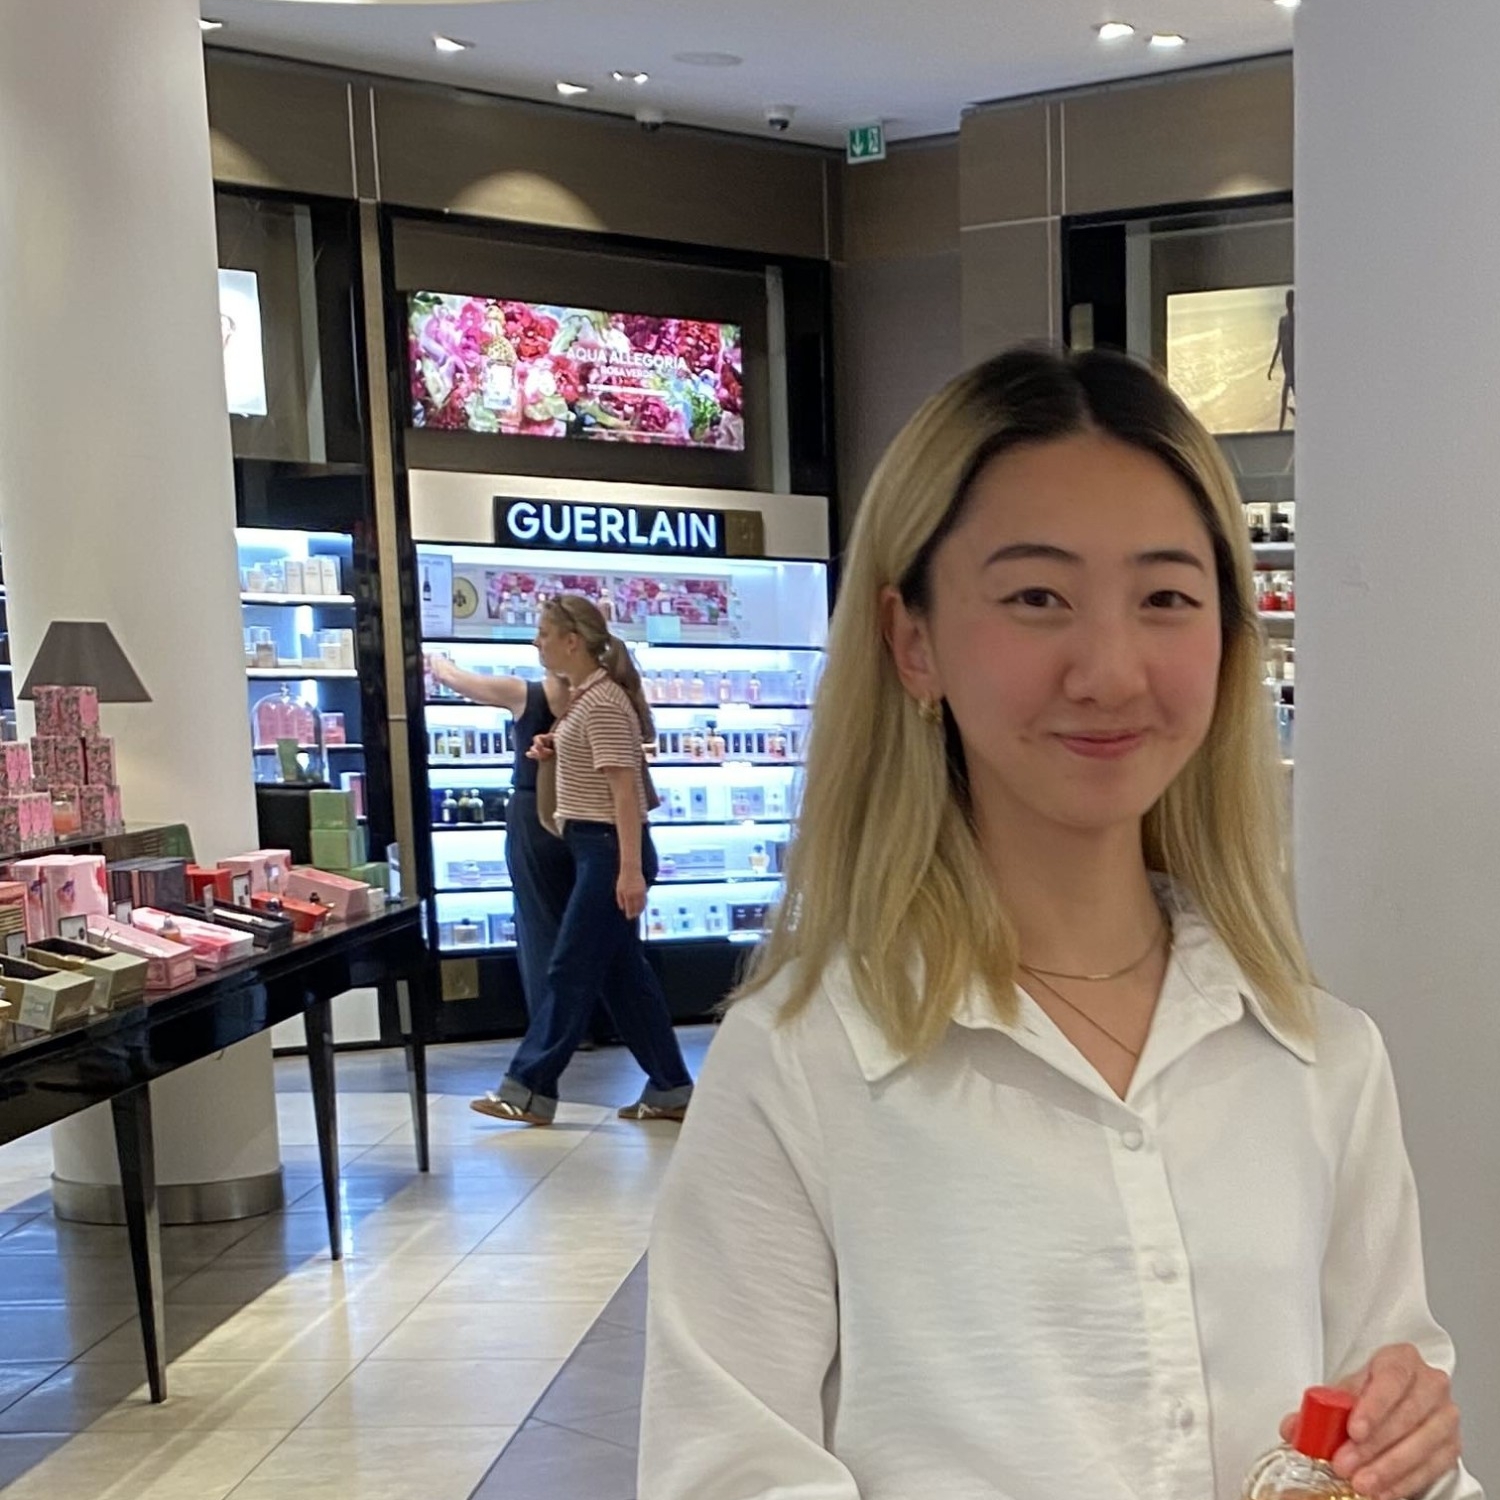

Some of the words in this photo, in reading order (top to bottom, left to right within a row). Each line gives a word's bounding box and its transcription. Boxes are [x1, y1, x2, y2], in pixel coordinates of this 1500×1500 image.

[566, 347, 608, 363] AQUA
[608, 349, 687, 370] ALLEGORIA
[507, 501, 717, 549] GUERLAIN
